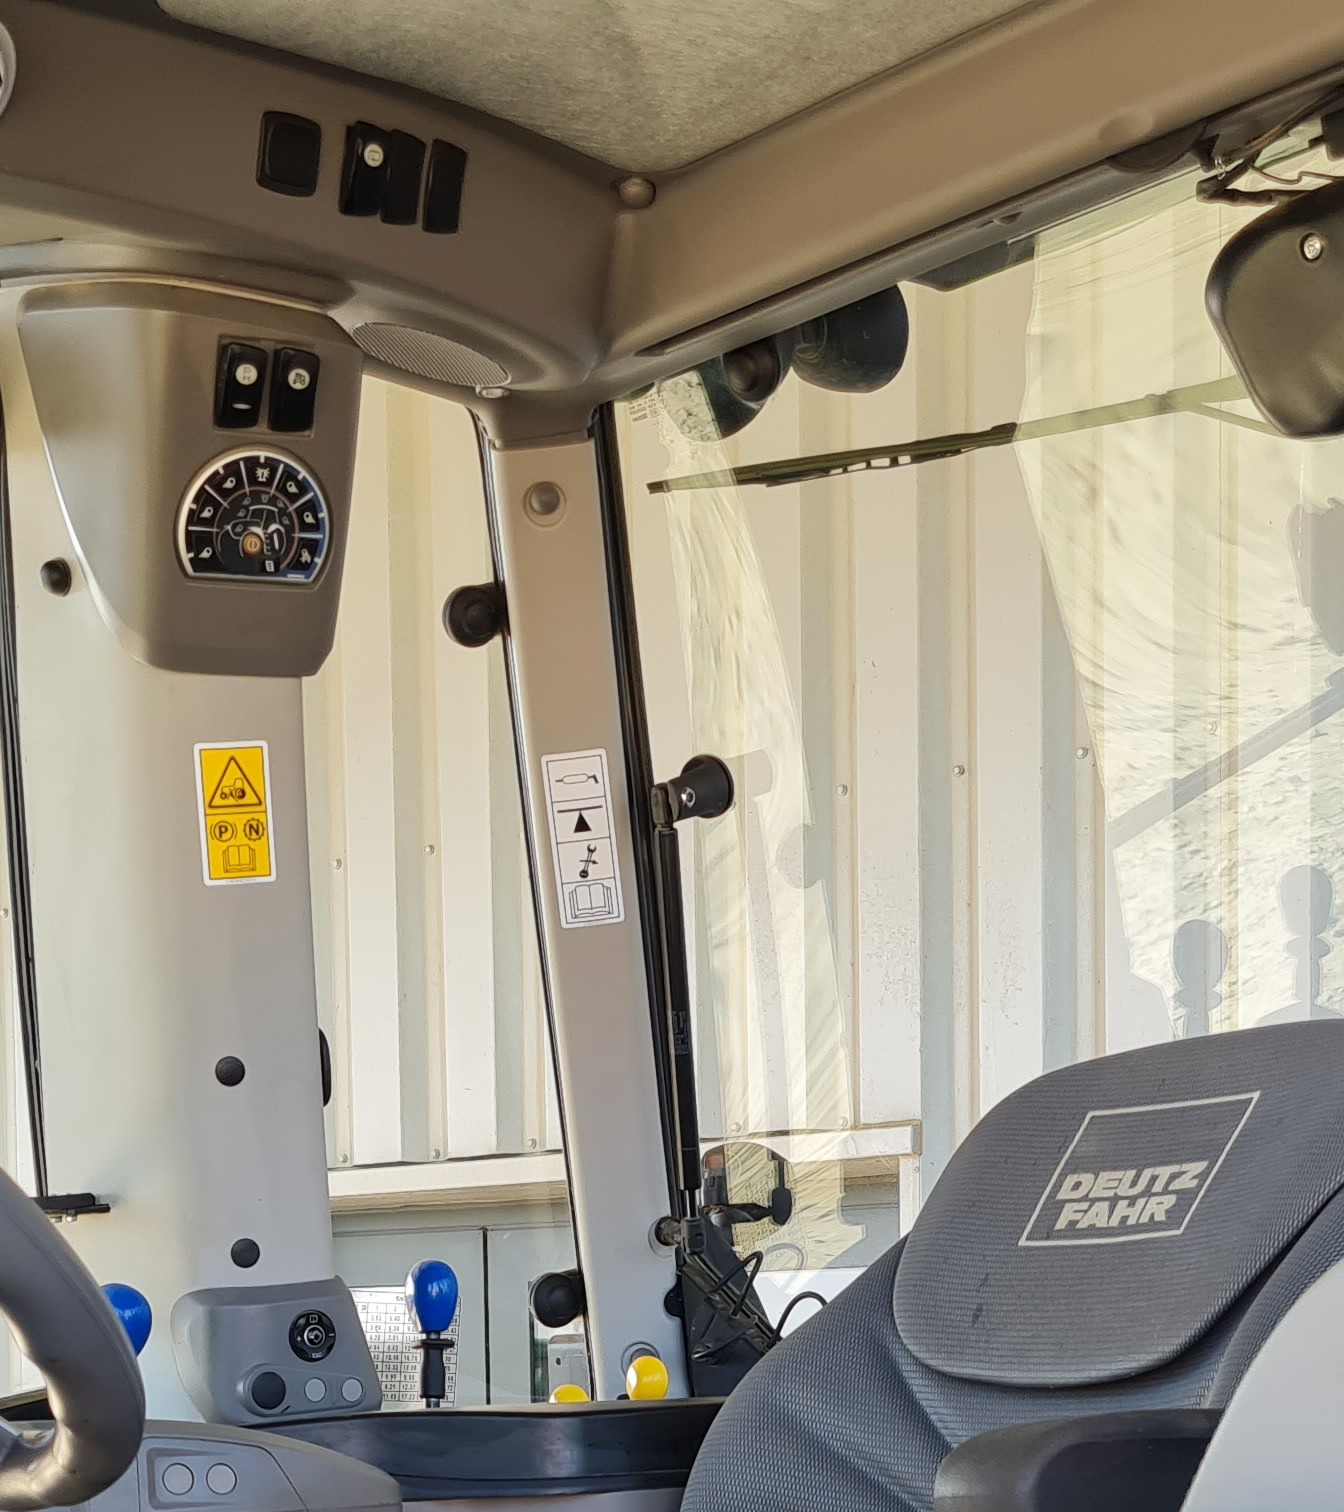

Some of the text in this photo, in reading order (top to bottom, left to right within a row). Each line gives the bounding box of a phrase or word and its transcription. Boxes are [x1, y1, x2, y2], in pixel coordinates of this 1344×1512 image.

[218, 823, 259, 838] P N
[1055, 1160, 1209, 1201] DEUTZ
[1054, 1193, 1178, 1230] FAHR
